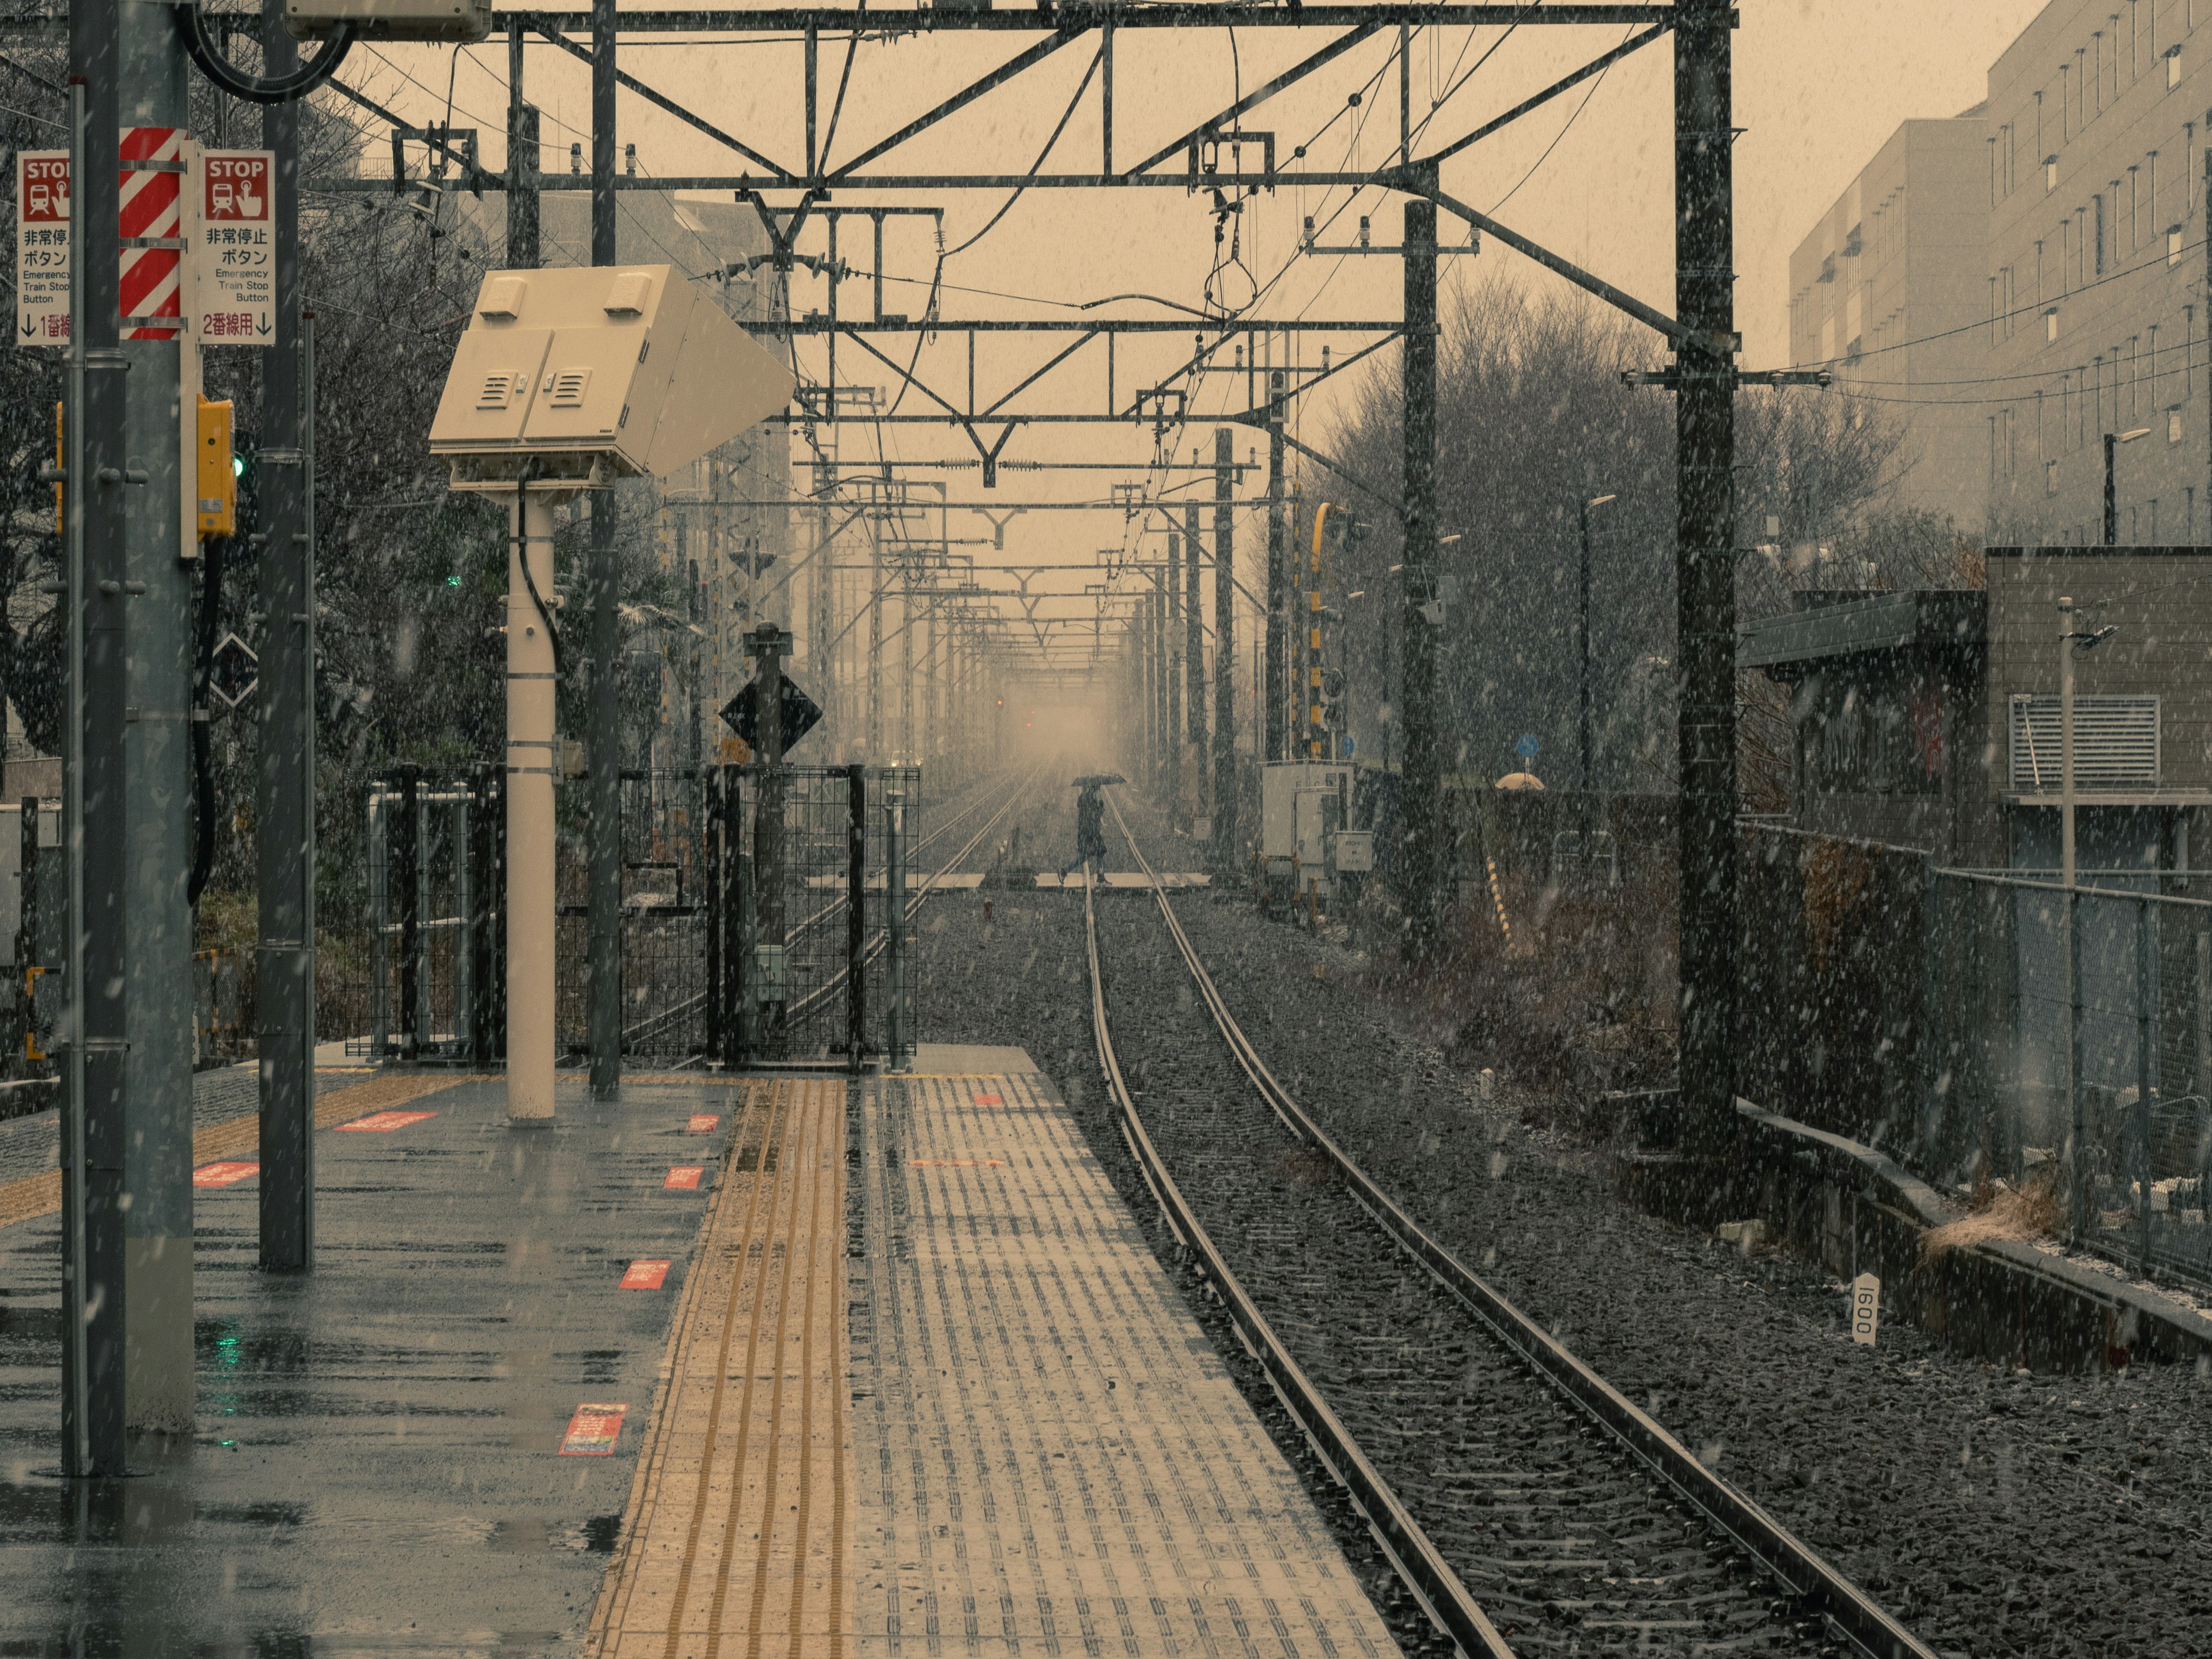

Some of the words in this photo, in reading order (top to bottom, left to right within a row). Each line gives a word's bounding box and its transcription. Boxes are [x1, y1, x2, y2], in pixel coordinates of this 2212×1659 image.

[28, 162, 70, 179] STO
[209, 161, 264, 177] STOP
[24, 229, 70, 246] 非常停
[206, 228, 268, 244] 非常停止
[24, 249, 66, 267] ボタン
[222, 249, 267, 265] ボタン
[215, 268, 268, 278] Emergency
[24, 282, 46, 291] Train
[50, 282, 70, 291] Stop
[219, 281, 243, 290] Train
[247, 281, 268, 290] Stop
[23, 294, 54, 304] Button
[236, 293, 268, 302] Button
[203, 312, 253, 336] 2番線用
[1856, 1287, 1874, 1334] 1600
